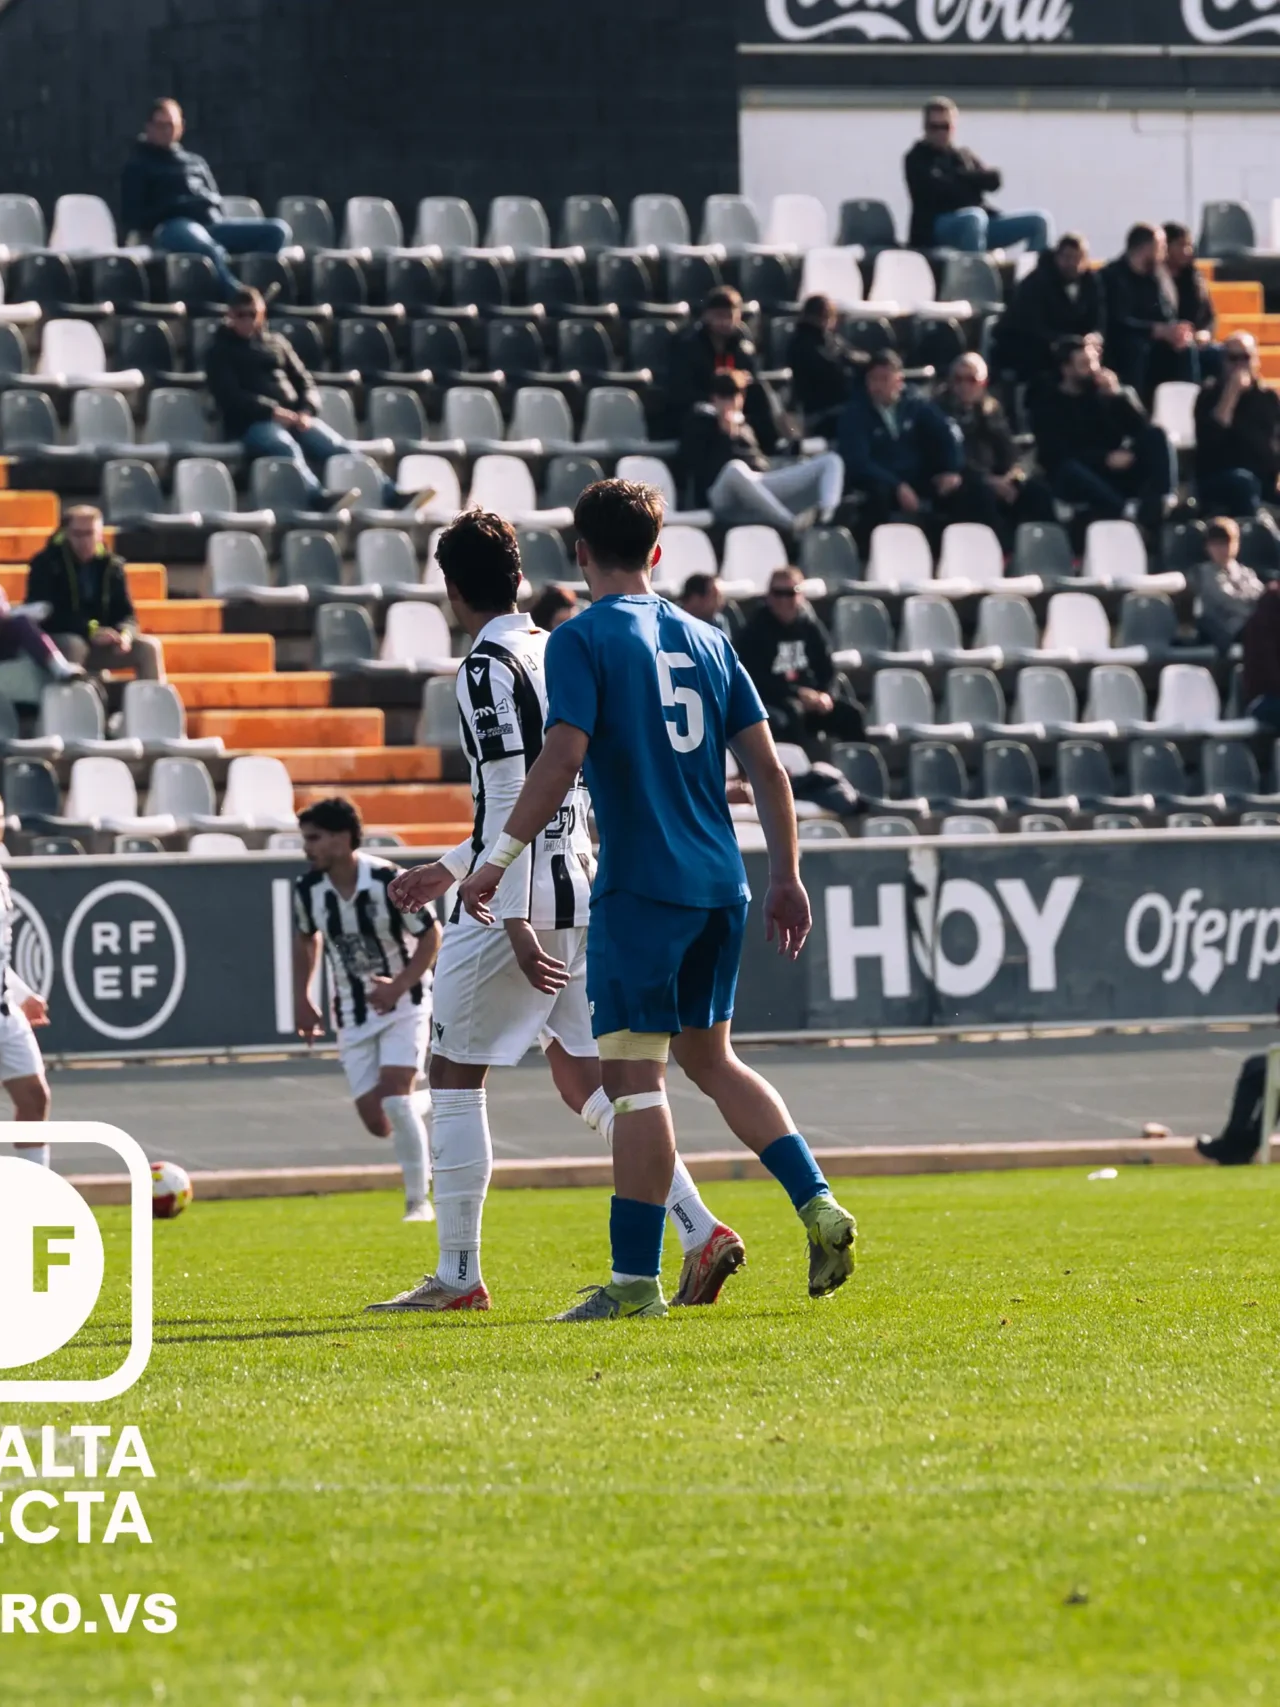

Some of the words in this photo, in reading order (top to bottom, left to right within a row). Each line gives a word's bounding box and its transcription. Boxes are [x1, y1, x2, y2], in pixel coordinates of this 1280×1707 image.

[655, 649, 705, 754] 5
[824, 876, 1082, 1001] HOY
[672, 1202, 696, 1234] DESIGN
[458, 1250, 469, 1281] ESIGN
